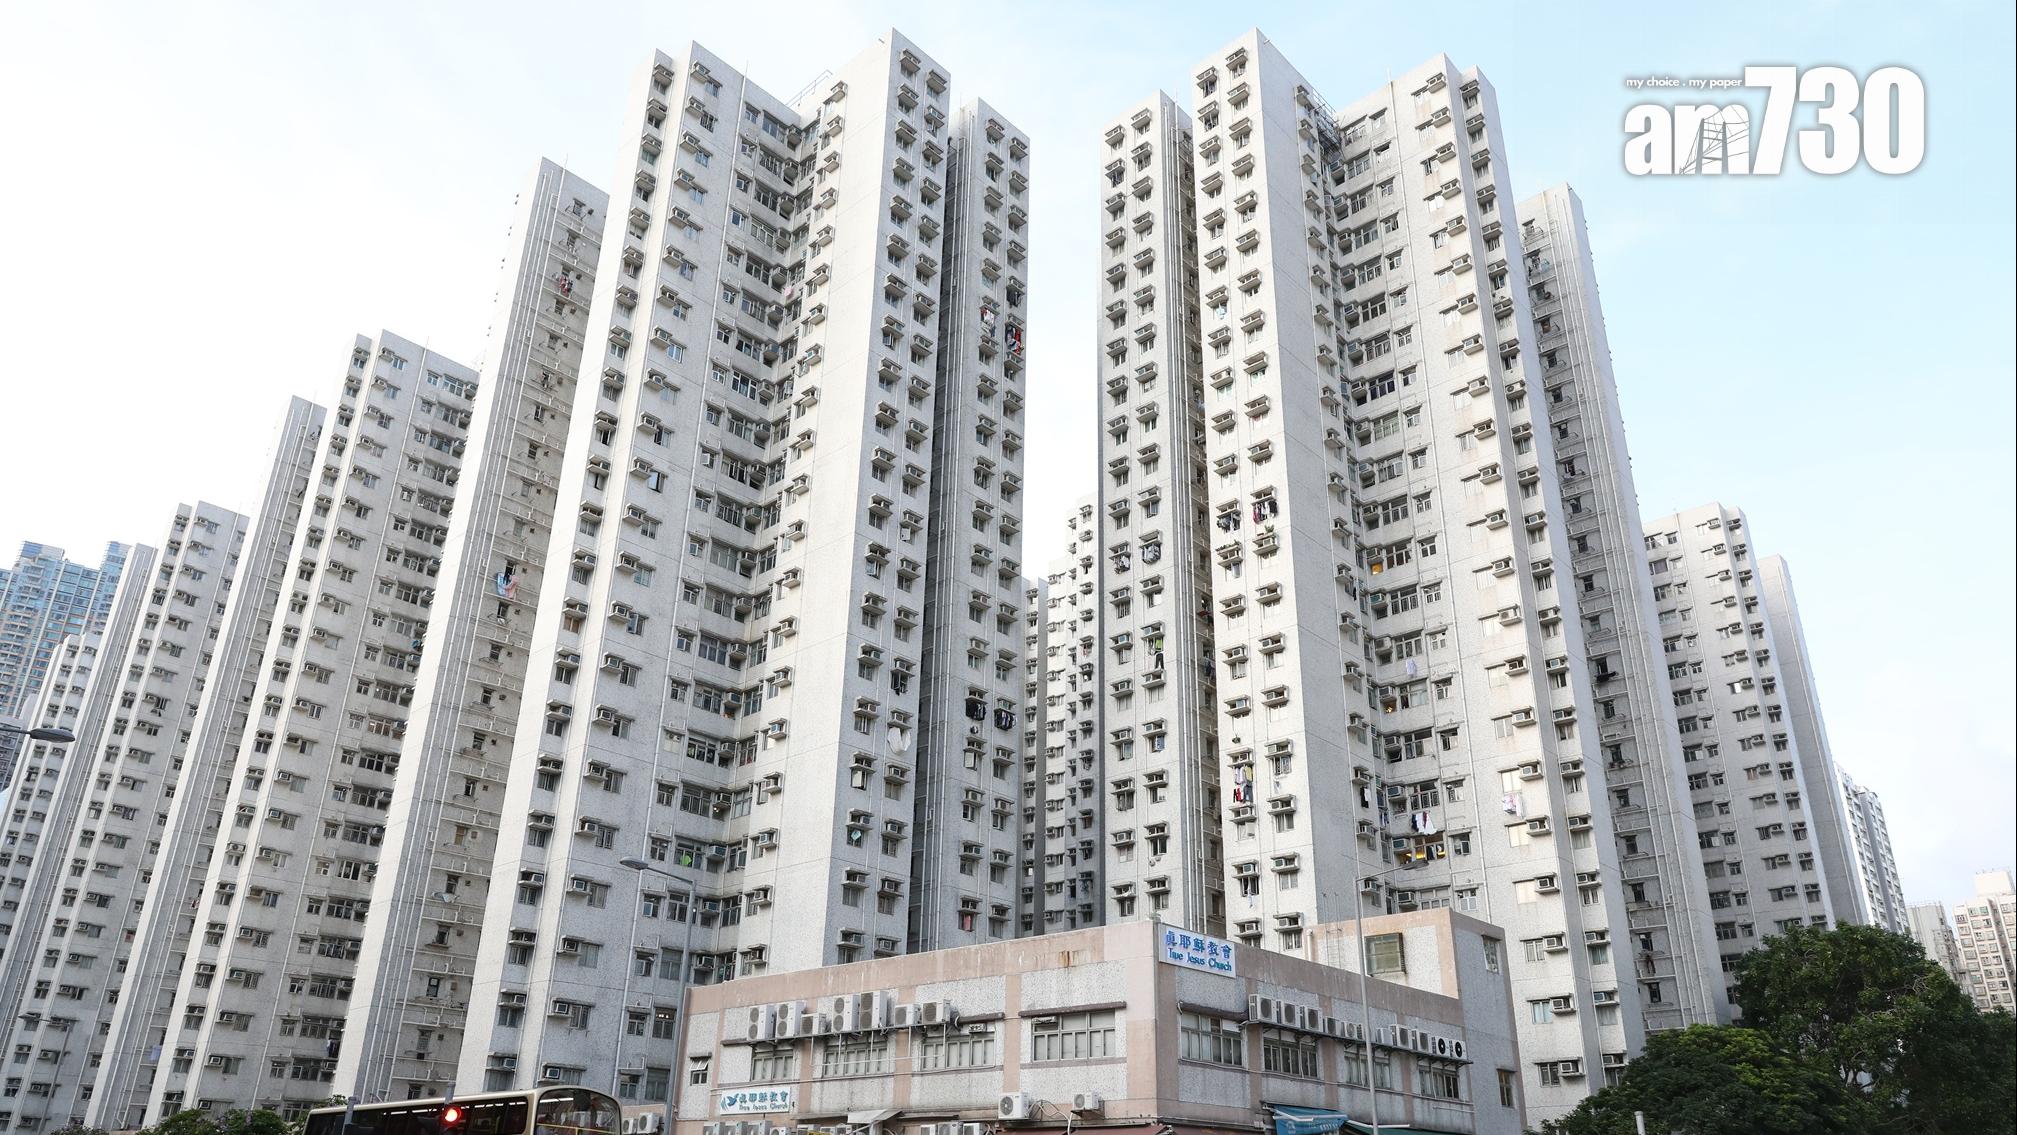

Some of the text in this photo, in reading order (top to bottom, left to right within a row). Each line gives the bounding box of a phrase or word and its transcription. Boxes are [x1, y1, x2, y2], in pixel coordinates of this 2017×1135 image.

[1168, 947, 1232, 971] True Jesus Church
